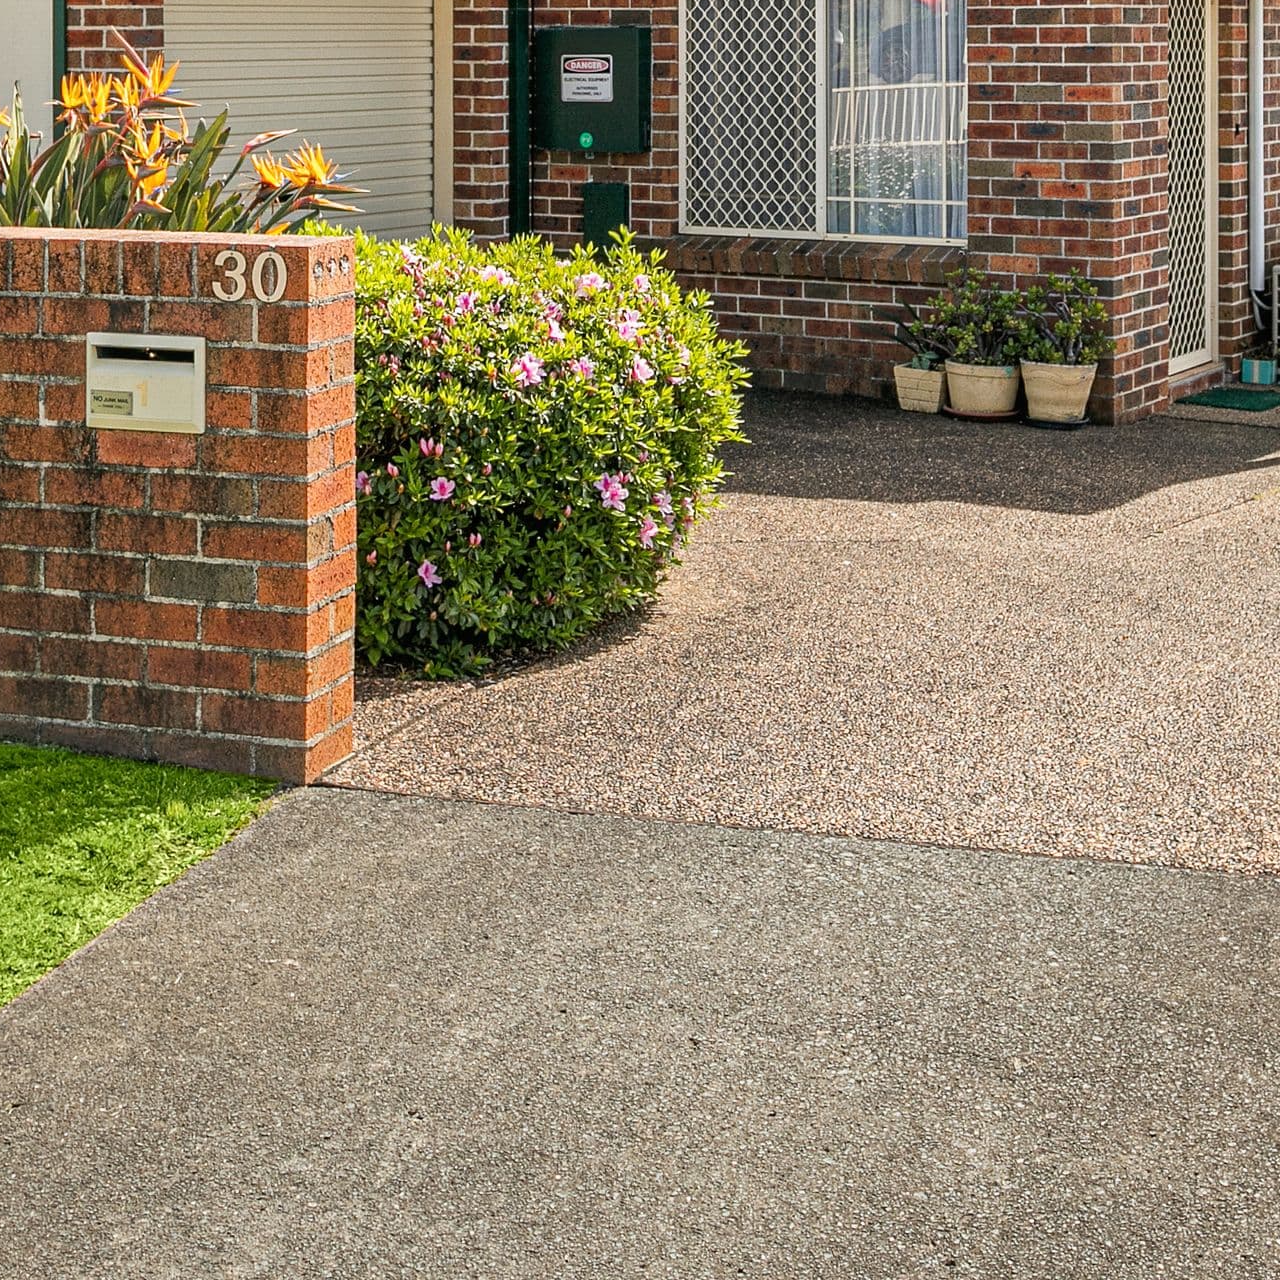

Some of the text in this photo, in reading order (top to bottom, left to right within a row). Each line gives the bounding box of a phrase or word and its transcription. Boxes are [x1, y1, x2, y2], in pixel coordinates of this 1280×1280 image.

[571, 61, 602, 70] DANGER
[212, 250, 288, 303] 30
[136, 380, 148, 407] 1
